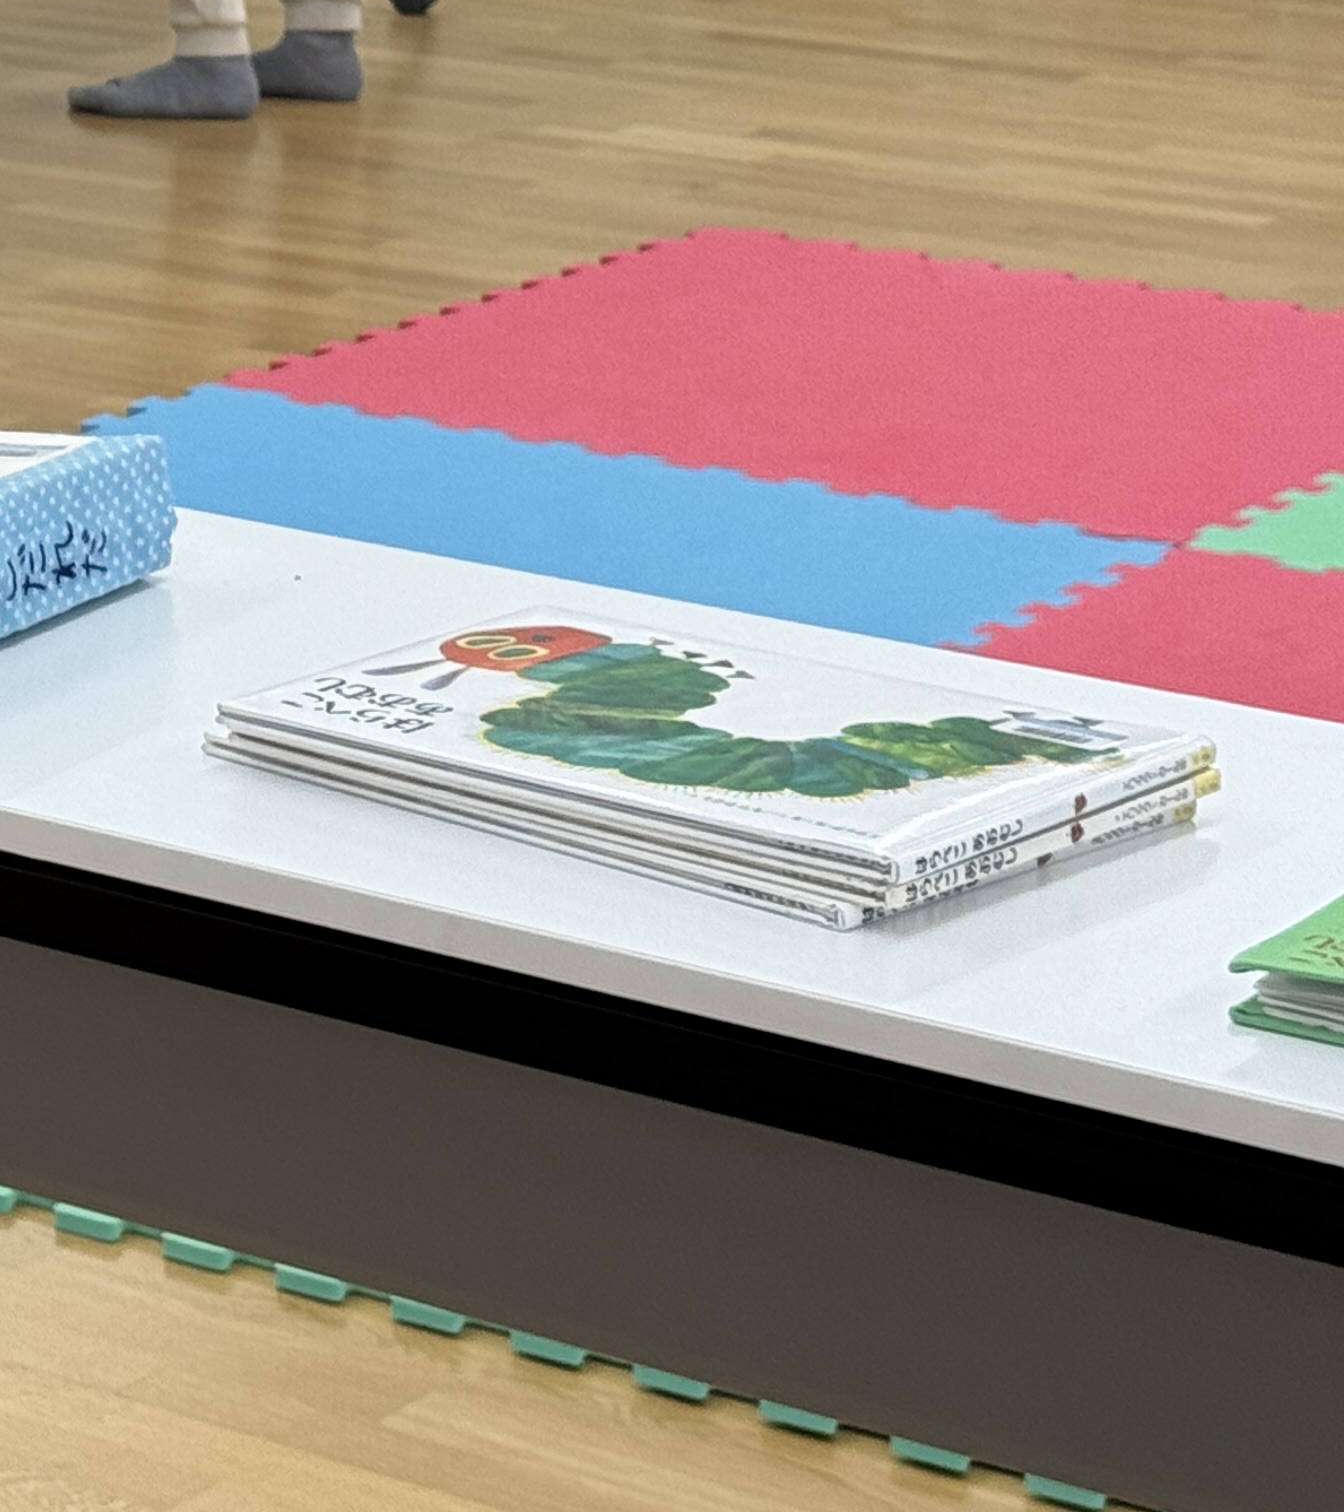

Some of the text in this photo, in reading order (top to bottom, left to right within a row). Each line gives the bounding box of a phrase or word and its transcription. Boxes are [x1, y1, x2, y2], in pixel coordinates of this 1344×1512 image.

[281, 692, 434, 734] はらぺこ
[313, 677, 454, 718] あおむし
[914, 840, 968, 876] はらぺこ
[973, 818, 1025, 853] あおむし
